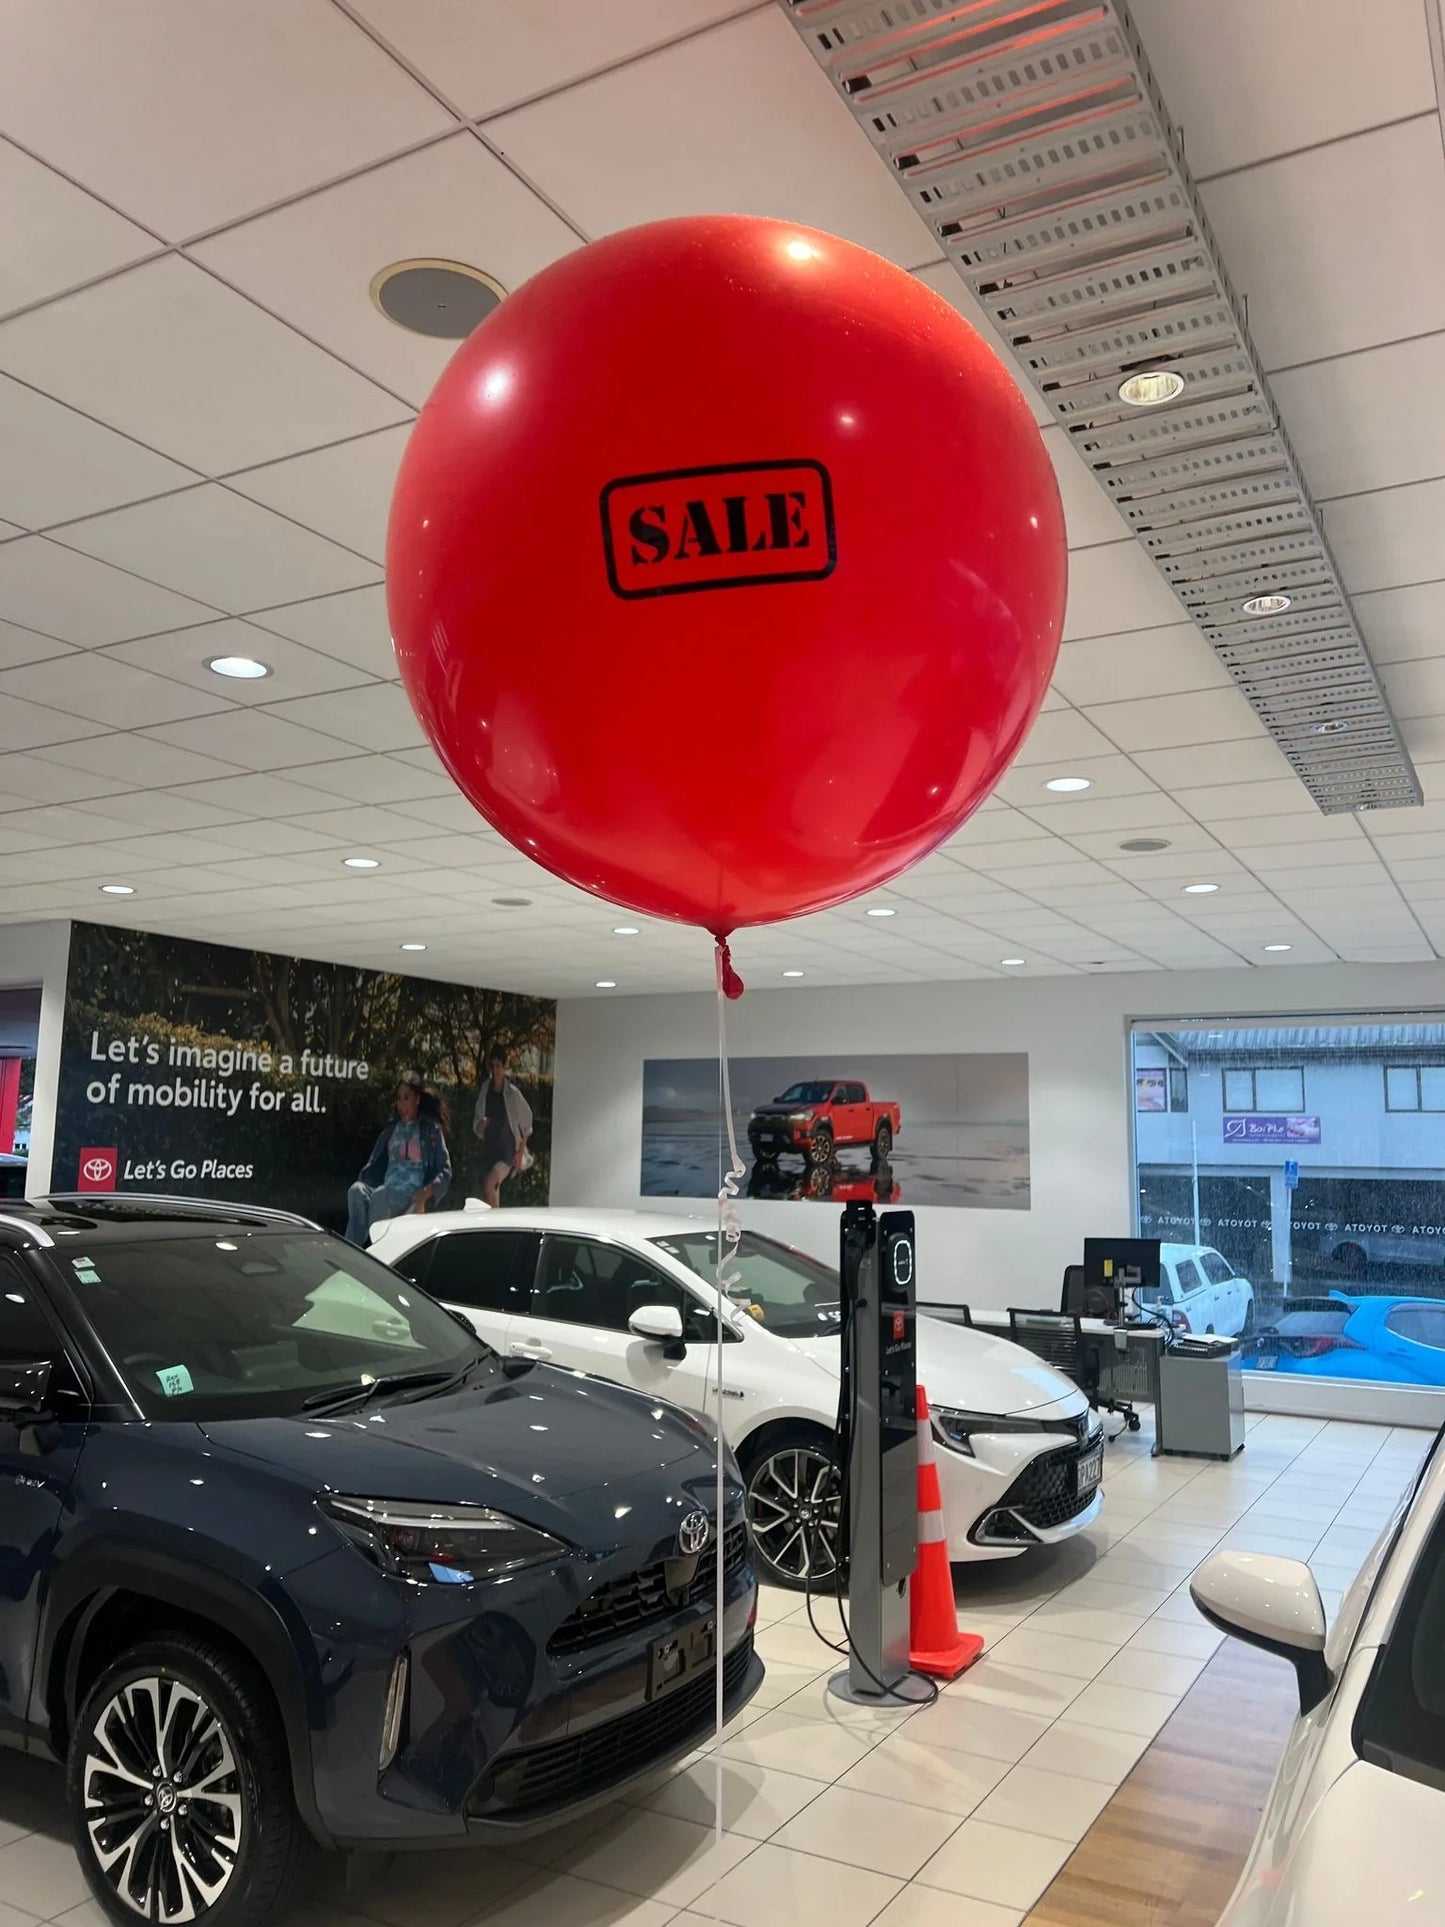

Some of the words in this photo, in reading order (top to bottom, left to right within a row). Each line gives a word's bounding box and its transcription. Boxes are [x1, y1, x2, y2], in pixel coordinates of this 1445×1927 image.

[629, 492, 810, 566] SALE
[90, 1030, 160, 1065] Let's
[168, 1037, 272, 1077] imagine
[279, 1053, 294, 1075] a
[300, 1049, 369, 1080] future
[86, 1073, 122, 1104] of
[127, 1077, 243, 1116] mobility
[249, 1082, 286, 1111] for
[290, 1084, 327, 1113] all.
[123, 1159, 166, 1180] Let's
[170, 1159, 197, 1179] Go
[200, 1158, 253, 1179] Places
